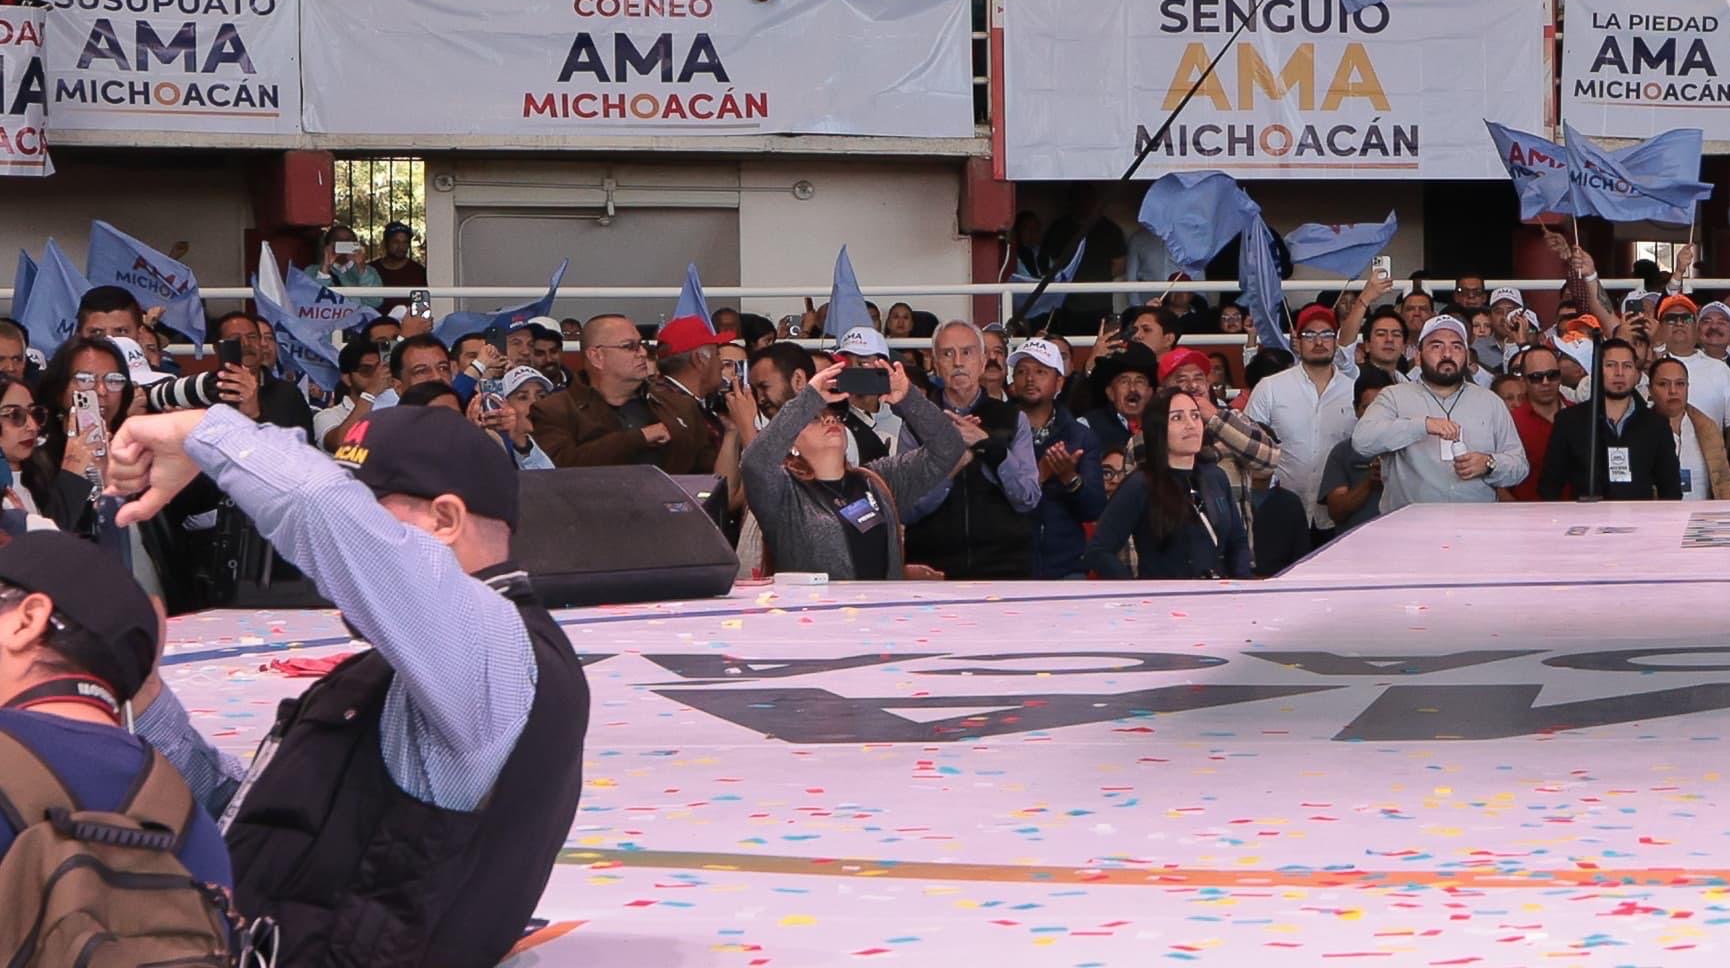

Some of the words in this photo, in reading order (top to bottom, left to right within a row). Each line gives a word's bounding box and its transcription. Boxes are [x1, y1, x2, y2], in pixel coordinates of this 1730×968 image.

[1592, 12, 1622, 31] LA
[1629, 14, 1719, 33] PIEDAD
[76, 18, 257, 75] AMA
[557, 32, 731, 83] AMA
[1590, 36, 1719, 77] AMA
[1160, 42, 1392, 112] AMA
[55, 78, 279, 109] MICHOACÁN
[523, 87, 769, 119] MICHOACÁN
[1134, 116, 1419, 158] MICHOACÁN
[1509, 141, 1566, 169] AM
[1569, 170, 1637, 194] MICHO
[115, 270, 174, 299] MICHO
[1495, 289, 1515, 297] AMA
[298, 305, 354, 320] MICHO
[841, 332, 863, 343] AMA
[1023, 339, 1047, 351] AMA
[513, 367, 538, 379] AMA
